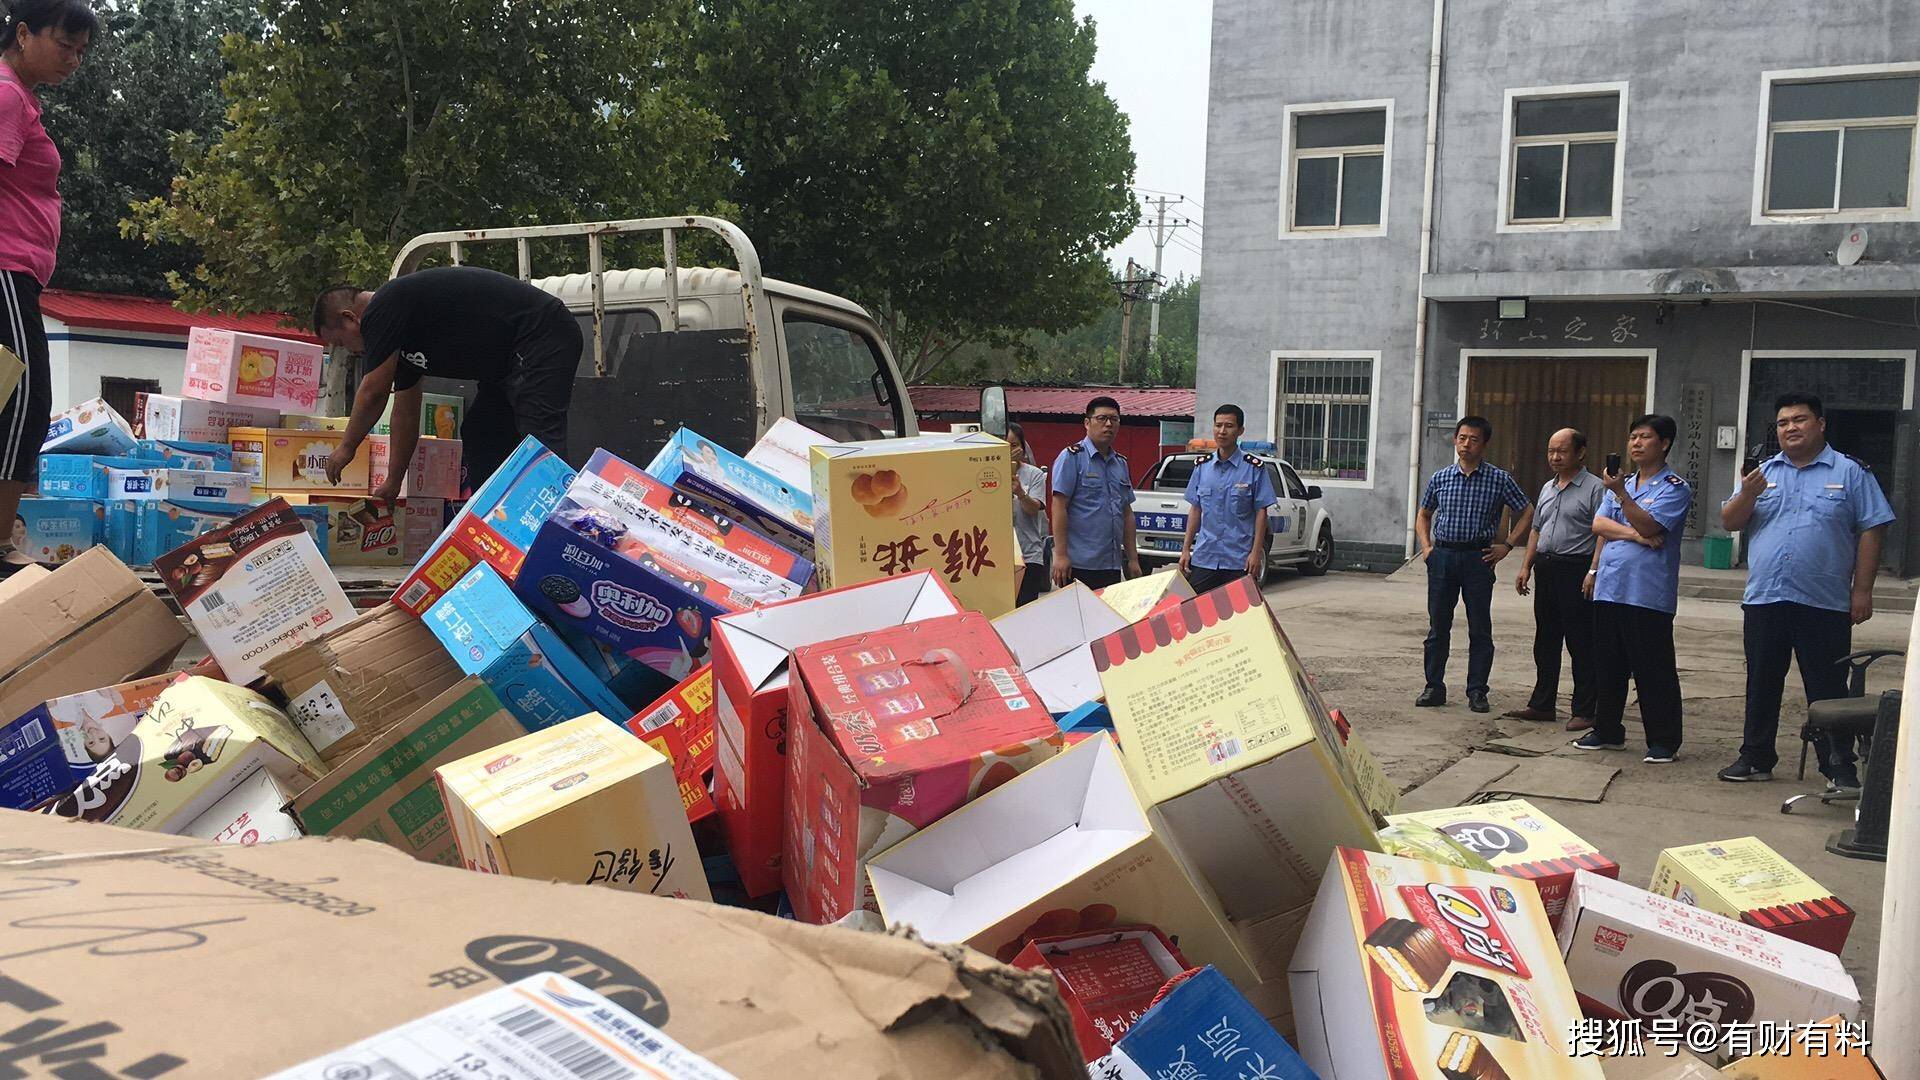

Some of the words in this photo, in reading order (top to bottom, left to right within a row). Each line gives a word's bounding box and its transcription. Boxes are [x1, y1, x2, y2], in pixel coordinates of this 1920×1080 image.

[307, 454, 331, 468] 小面
[1139, 515, 1183, 530] 市管理
[595, 583, 668, 624] 奥利加
[267, 617, 309, 649] MEIDEKE
[240, 641, 269, 663] FOOD
[485, 941, 663, 1013] OTC
